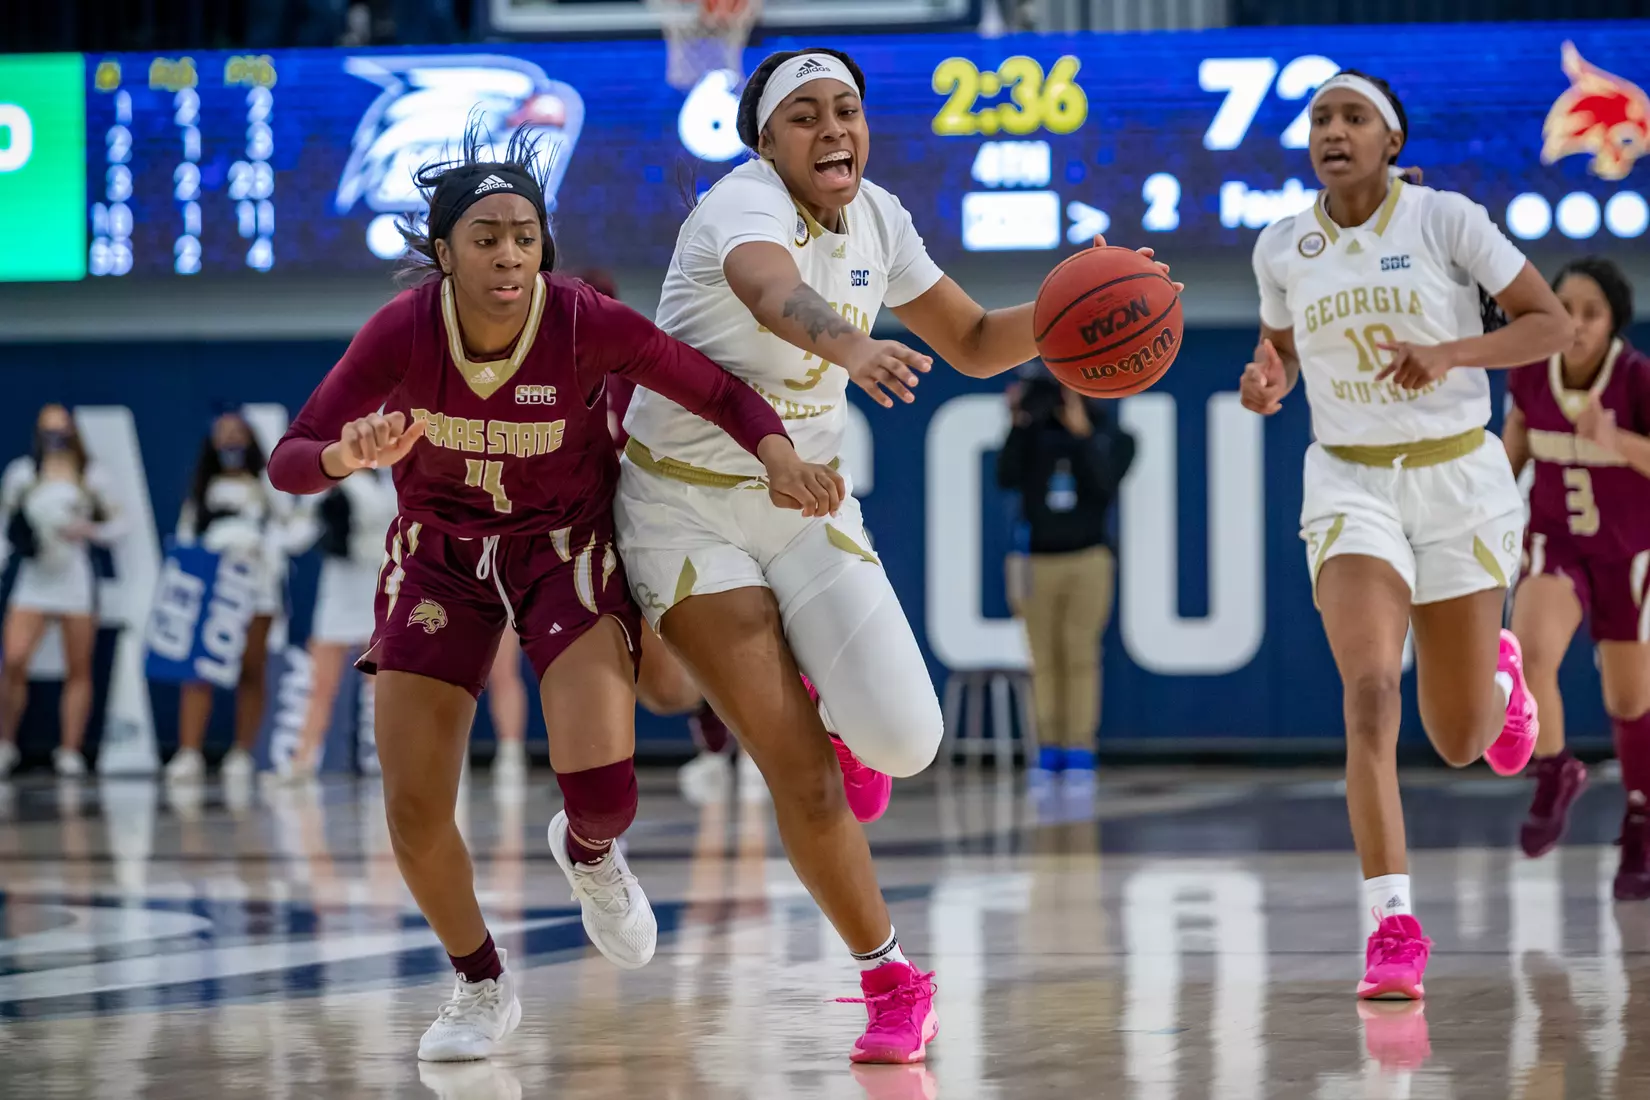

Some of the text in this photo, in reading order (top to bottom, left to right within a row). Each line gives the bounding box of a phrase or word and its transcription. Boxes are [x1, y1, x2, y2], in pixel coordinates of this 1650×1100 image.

[796, 66, 831, 78] adidas
[932, 55, 1088, 136] 2:36
[1199, 54, 1342, 151] 72
[475, 183, 513, 194] adidas
[1142, 173, 1181, 232] 2
[850, 269, 869, 286] SBC
[1380, 254, 1411, 271] SBC
[1080, 294, 1151, 345] NCAA
[1304, 286, 1424, 333] GEORGIA
[1080, 327, 1175, 379] Wilson
[1344, 322, 1399, 372] 10
[515, 385, 556, 405] SBC
[410, 407, 566, 458] TEXAS STATE
[1562, 466, 1600, 537] 3
